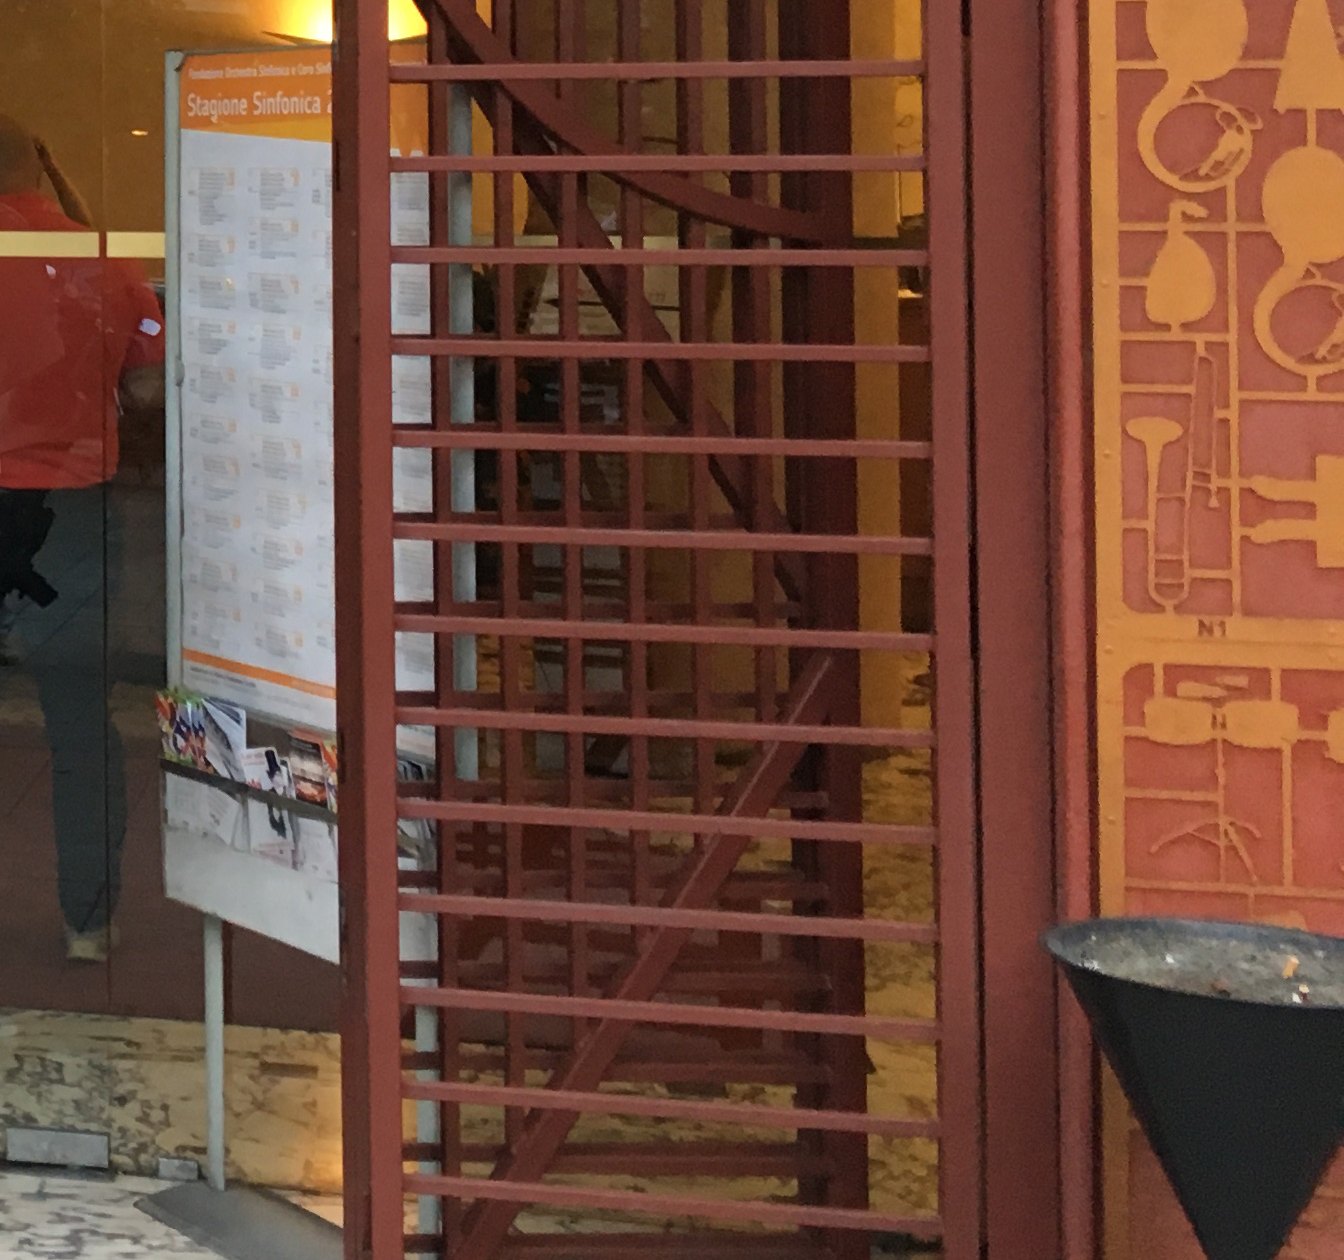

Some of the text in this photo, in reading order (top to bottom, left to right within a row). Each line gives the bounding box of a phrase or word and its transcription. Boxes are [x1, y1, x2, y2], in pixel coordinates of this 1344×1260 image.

[187, 92, 248, 124] Stagione
[253, 90, 321, 116] Sinfonica
[1197, 618, 1227, 637] N1
